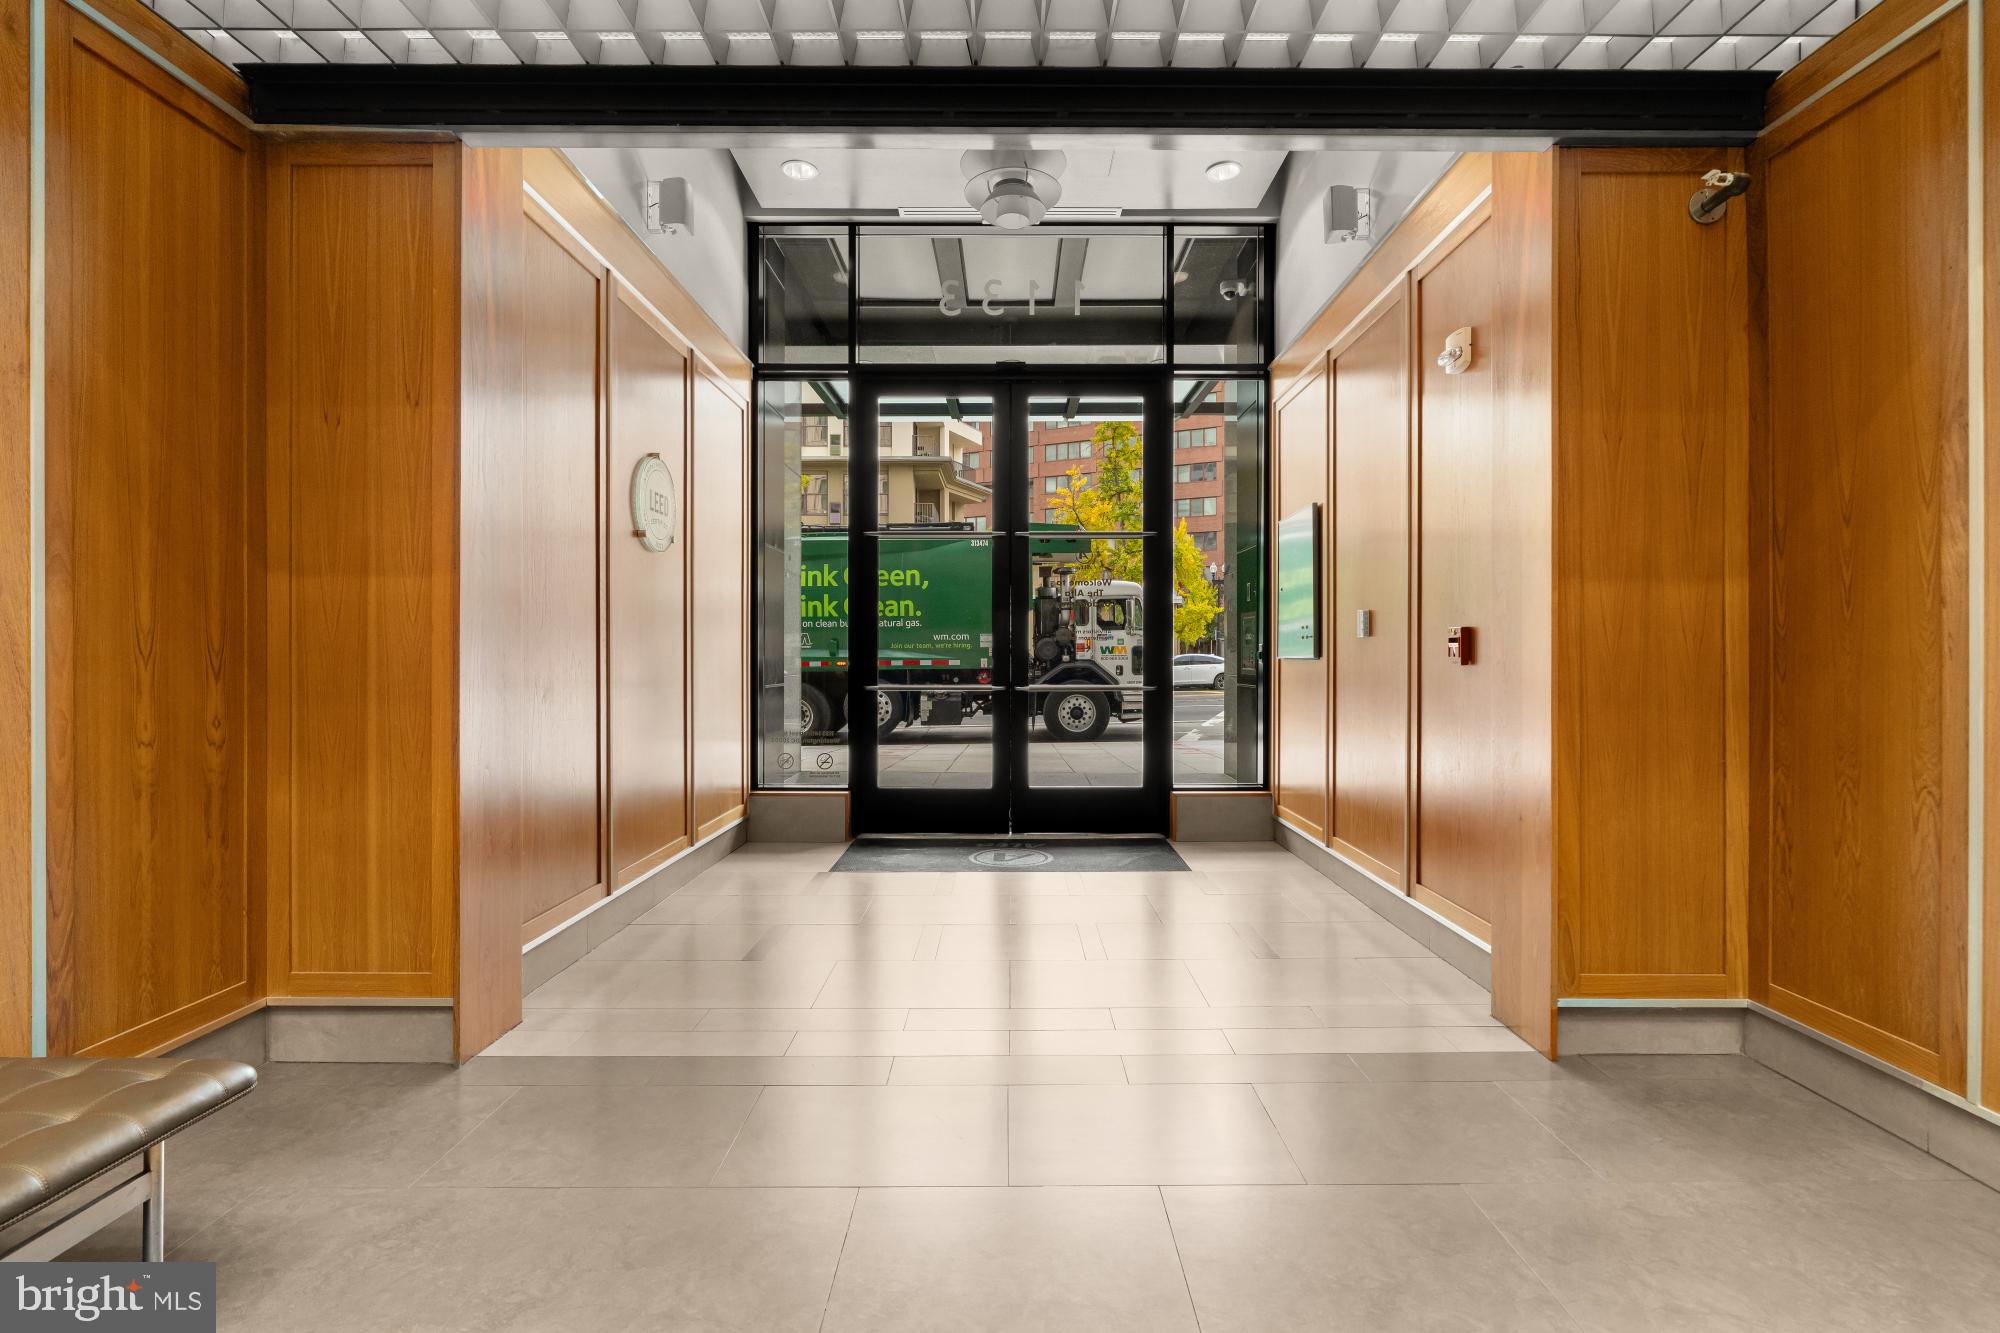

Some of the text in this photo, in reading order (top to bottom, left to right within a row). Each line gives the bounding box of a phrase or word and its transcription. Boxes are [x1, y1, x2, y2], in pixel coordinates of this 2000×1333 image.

[649, 489, 669, 517] LEED
[970, 539, 989, 547] 313474
[801, 563, 839, 587] ink
[801, 593, 839, 617] ink
[815, 619, 838, 628] clean
[878, 619, 904, 628] atural
[905, 620, 923, 630] gas.
[933, 633, 970, 641] wm.com
[1100, 645, 1128, 655] WM
